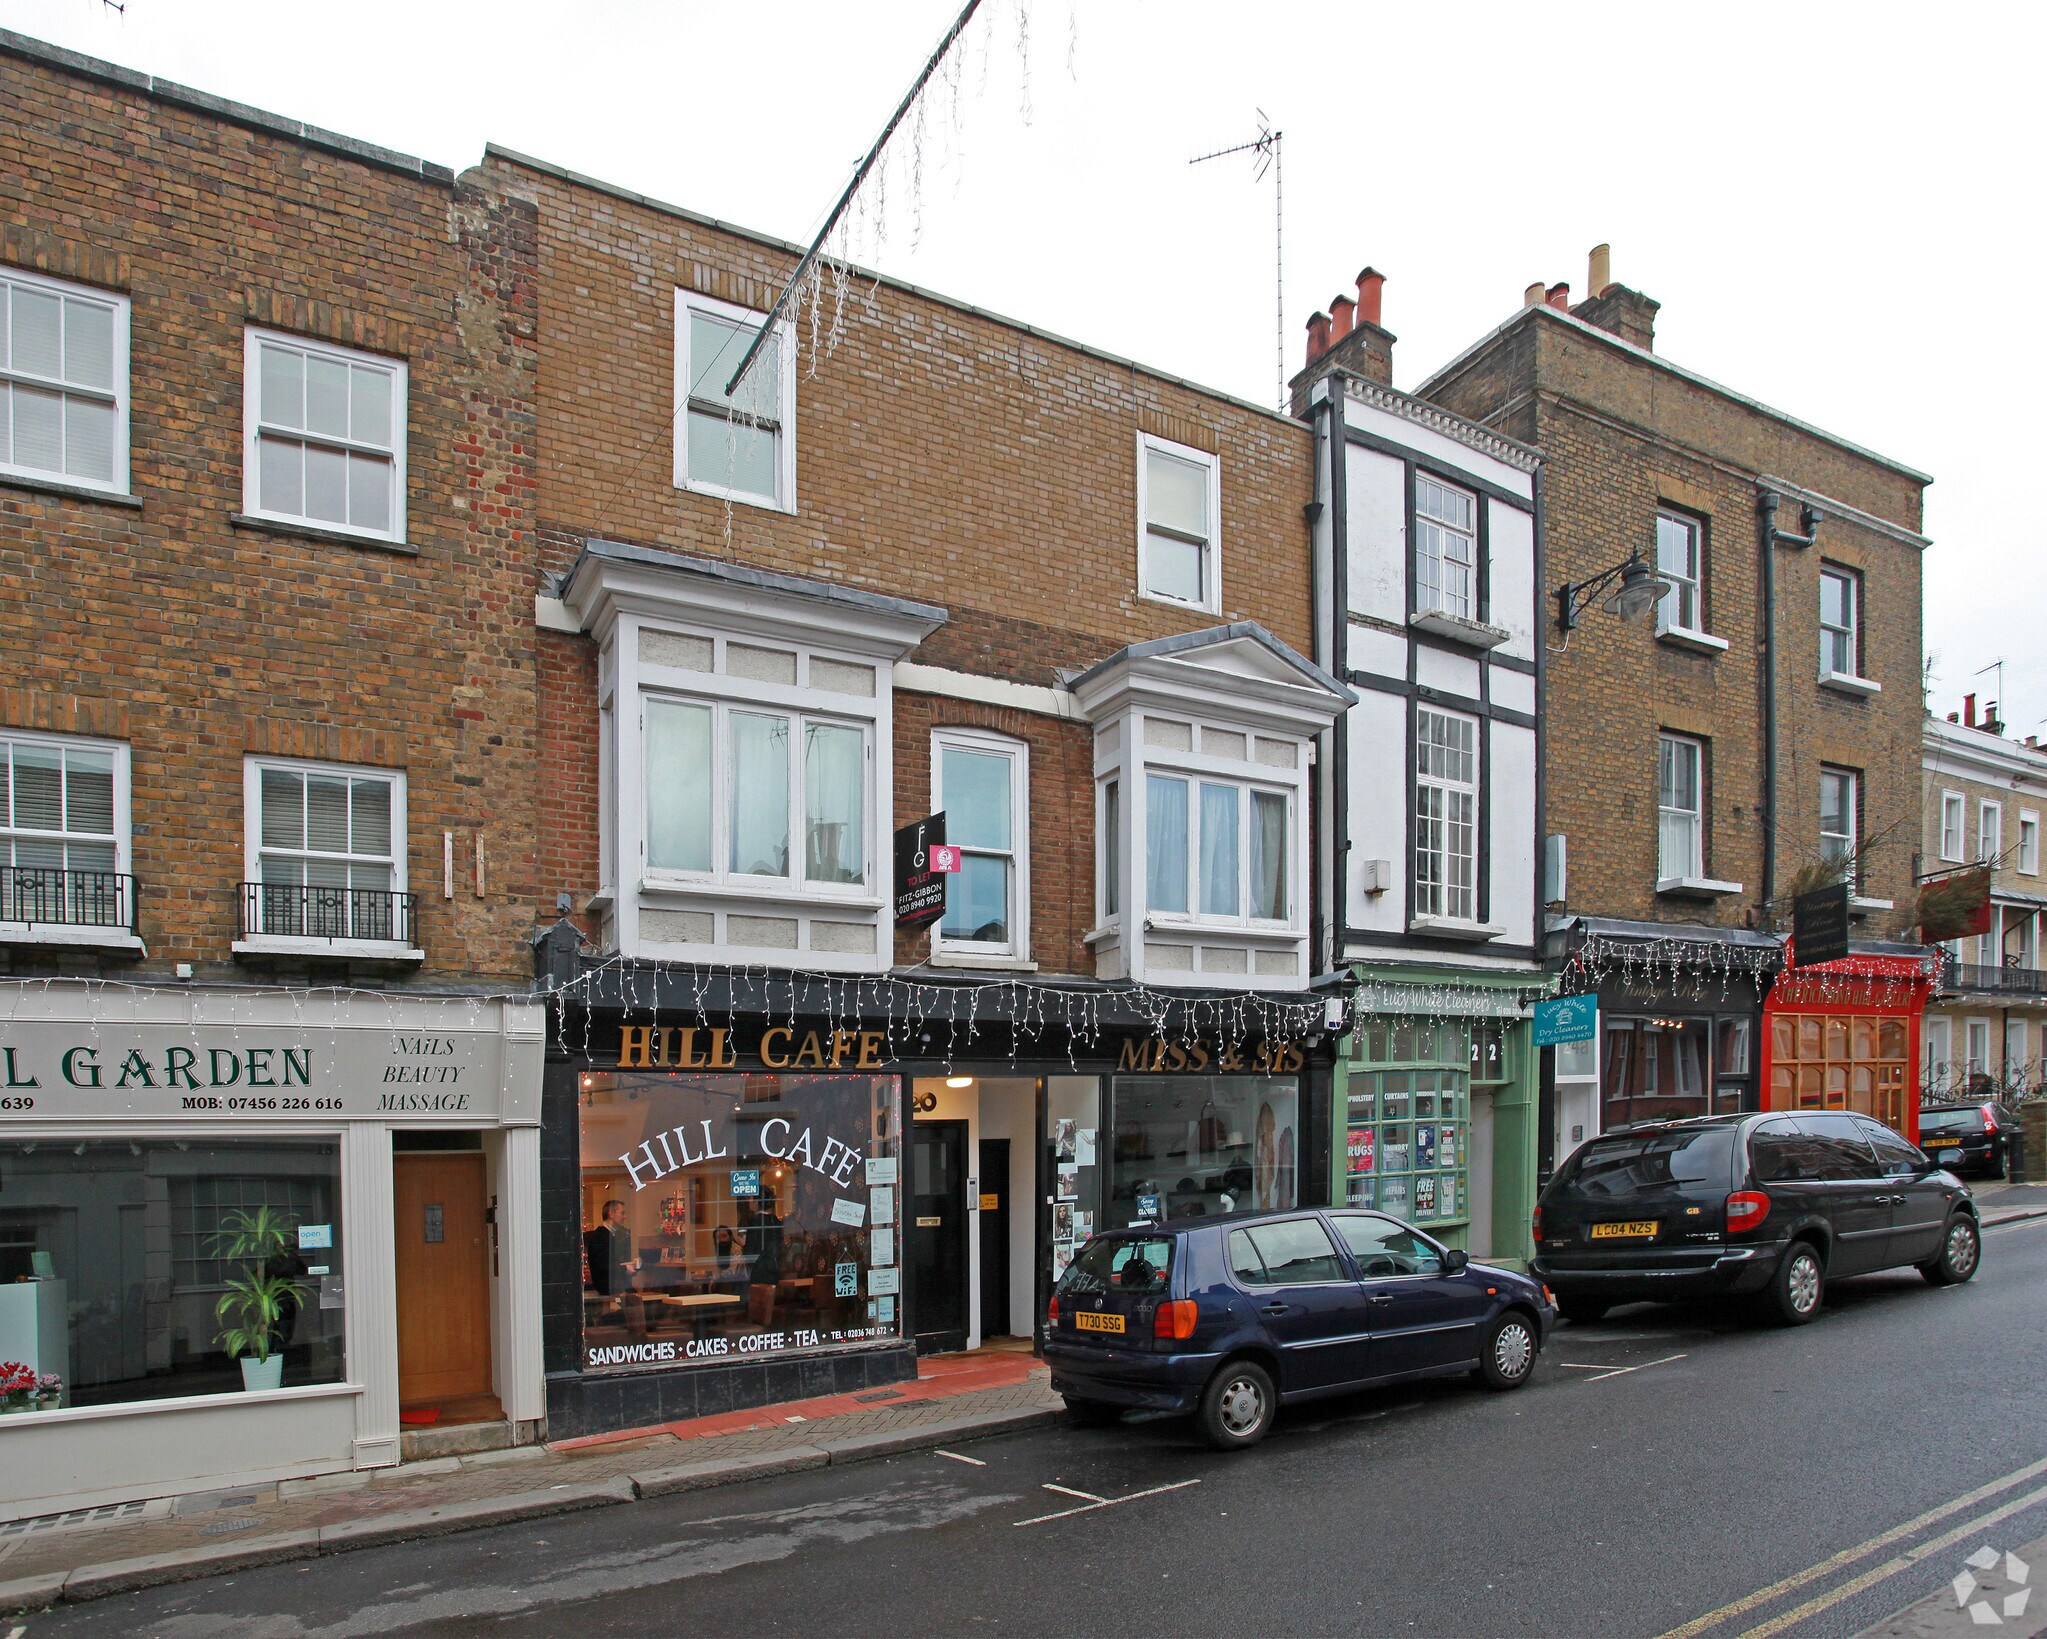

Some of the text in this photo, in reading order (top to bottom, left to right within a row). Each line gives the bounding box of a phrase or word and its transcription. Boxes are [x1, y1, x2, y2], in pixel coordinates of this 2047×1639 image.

[907, 871, 931, 887] TO LET
[898, 904, 910, 915] 020
[910, 899, 925, 909] 8940
[926, 893, 942, 906] 9920
[1383, 989, 1493, 1012] Lucy White Cleaners
[1782, 986, 1800, 1003] THE
[1542, 999, 1587, 1018] Lucy White
[1539, 1023, 1589, 1037] Dry Cleaners
[393, 1037, 455, 1056] NAILS
[616, 1026, 885, 1069] HILL CAFE
[1116, 1038, 1306, 1072] MISS & SIS
[1472, 1044, 1479, 1061] 2
[1489, 1044, 1496, 1061] 2
[0, 1046, 315, 1092] L GARDEN
[382, 1066, 466, 1083] BEAUTY
[182, 1097, 222, 1109] MOB:
[228, 1097, 277, 1110] 07456
[282, 1097, 310, 1110] 226
[315, 1097, 343, 1110] 616
[376, 1094, 470, 1111] MASSAGE
[913, 1091, 937, 1112] 20
[1384, 1092, 1408, 1100] CURTAINS
[619, 1118, 862, 1192] HILL CAFÉ
[1348, 1145, 1373, 1156] RUGS
[733, 1185, 757, 1194] OPEN
[1417, 1180, 1434, 1193] FREE
[1346, 1194, 1373, 1203] SLEEPING
[1686, 1207, 1700, 1215] GB
[301, 1230, 320, 1238] open
[1597, 1223, 1652, 1236] LC04 NZS
[837, 1265, 855, 1275] FREE
[836, 1286, 856, 1296] WiFi
[1079, 1314, 1121, 1330] T730 SSG
[589, 1342, 675, 1366] SANDWICHES
[686, 1337, 728, 1357] CAKES
[738, 1332, 785, 1353] COFFEE
[794, 1329, 819, 1347] TEA
[847, 1329, 864, 1338] 02036
[877, 1326, 887, 1335] 672
